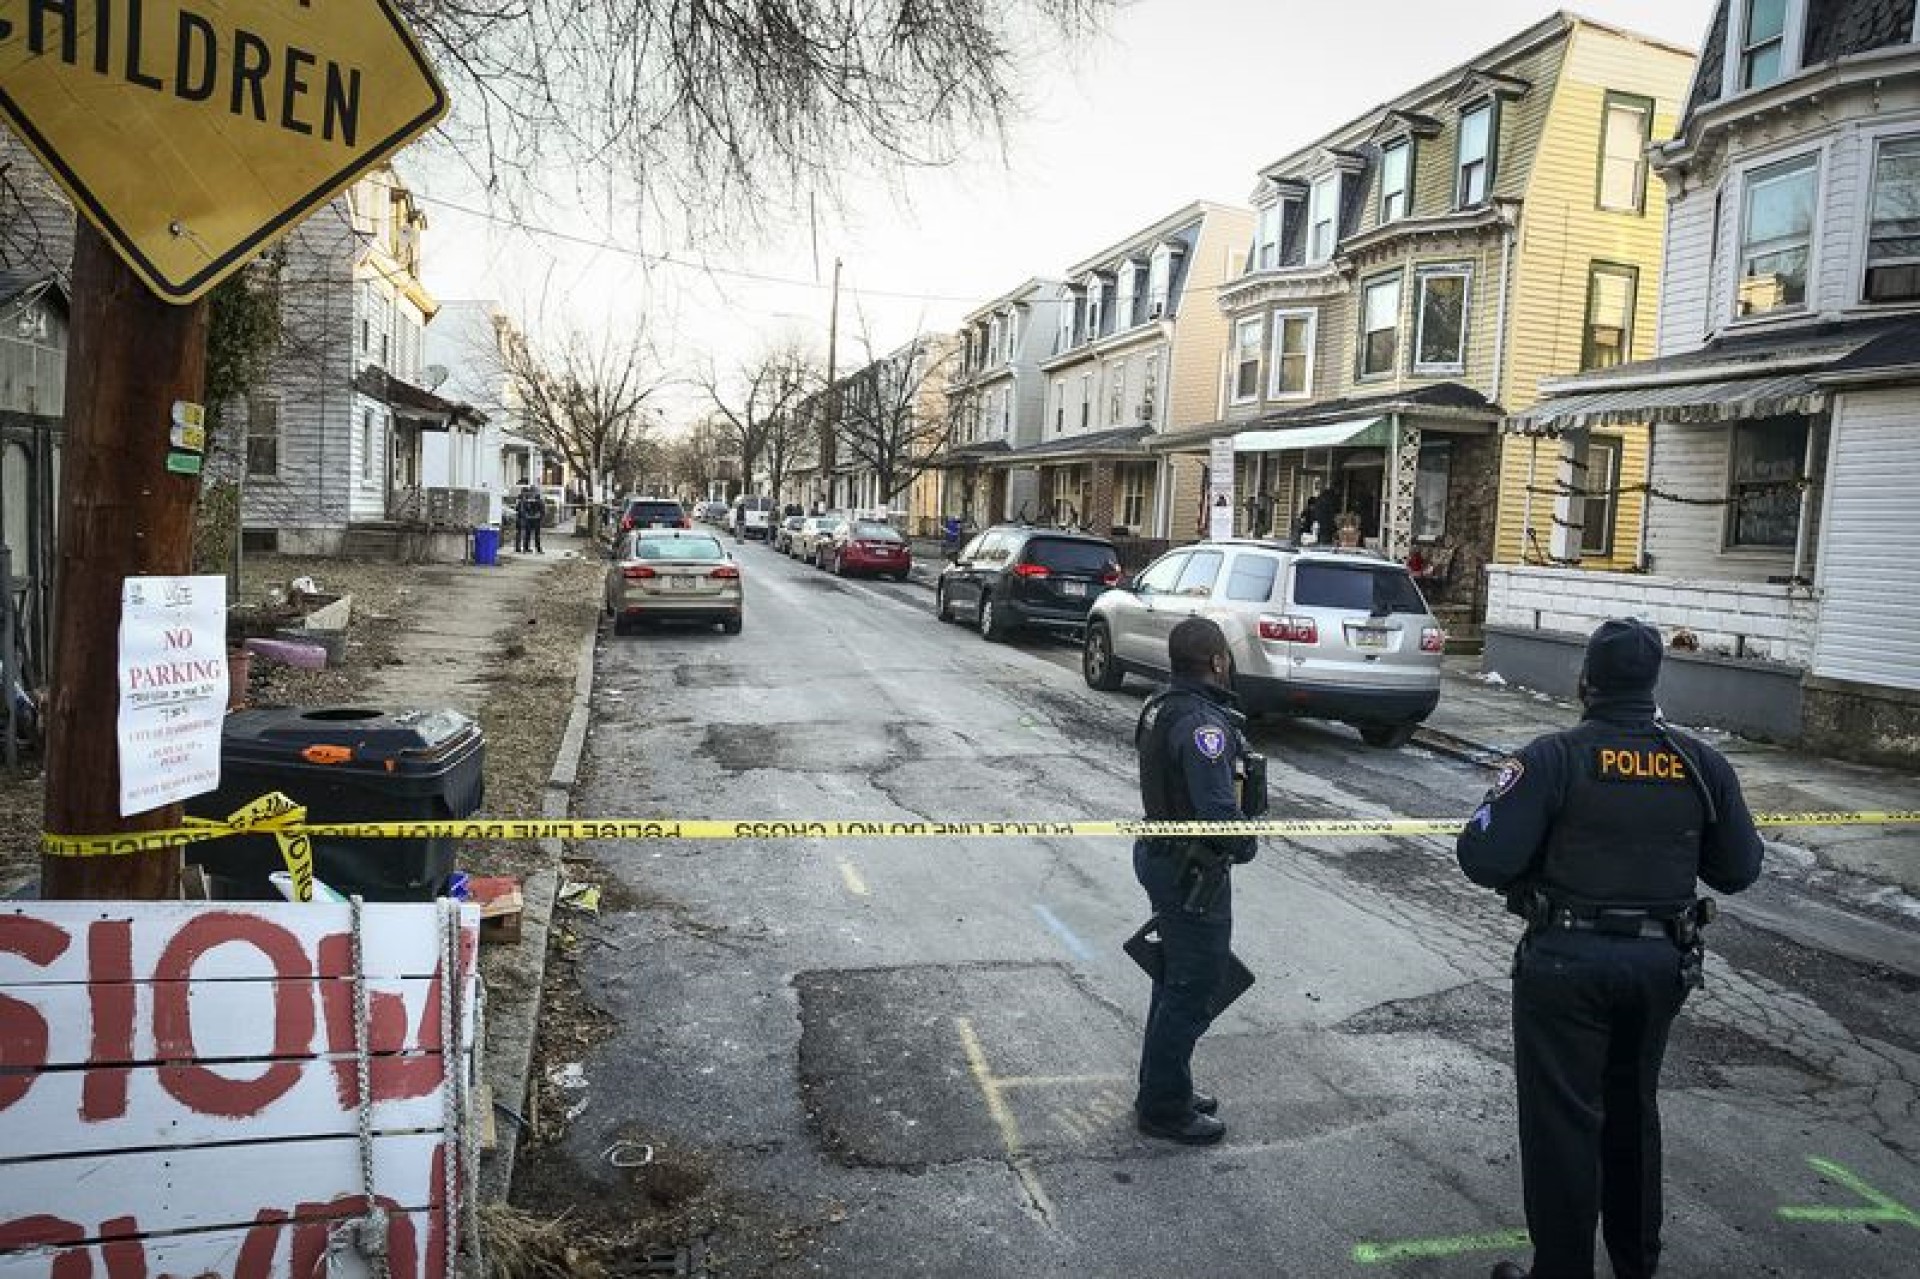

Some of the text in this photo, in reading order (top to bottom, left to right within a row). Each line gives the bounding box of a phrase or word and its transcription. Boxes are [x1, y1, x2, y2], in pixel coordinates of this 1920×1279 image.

[0, 0, 361, 147] HILDREN
[164, 629, 192, 650] NO
[129, 660, 221, 689] PARKING
[1602, 750, 1686, 779] POLICE
